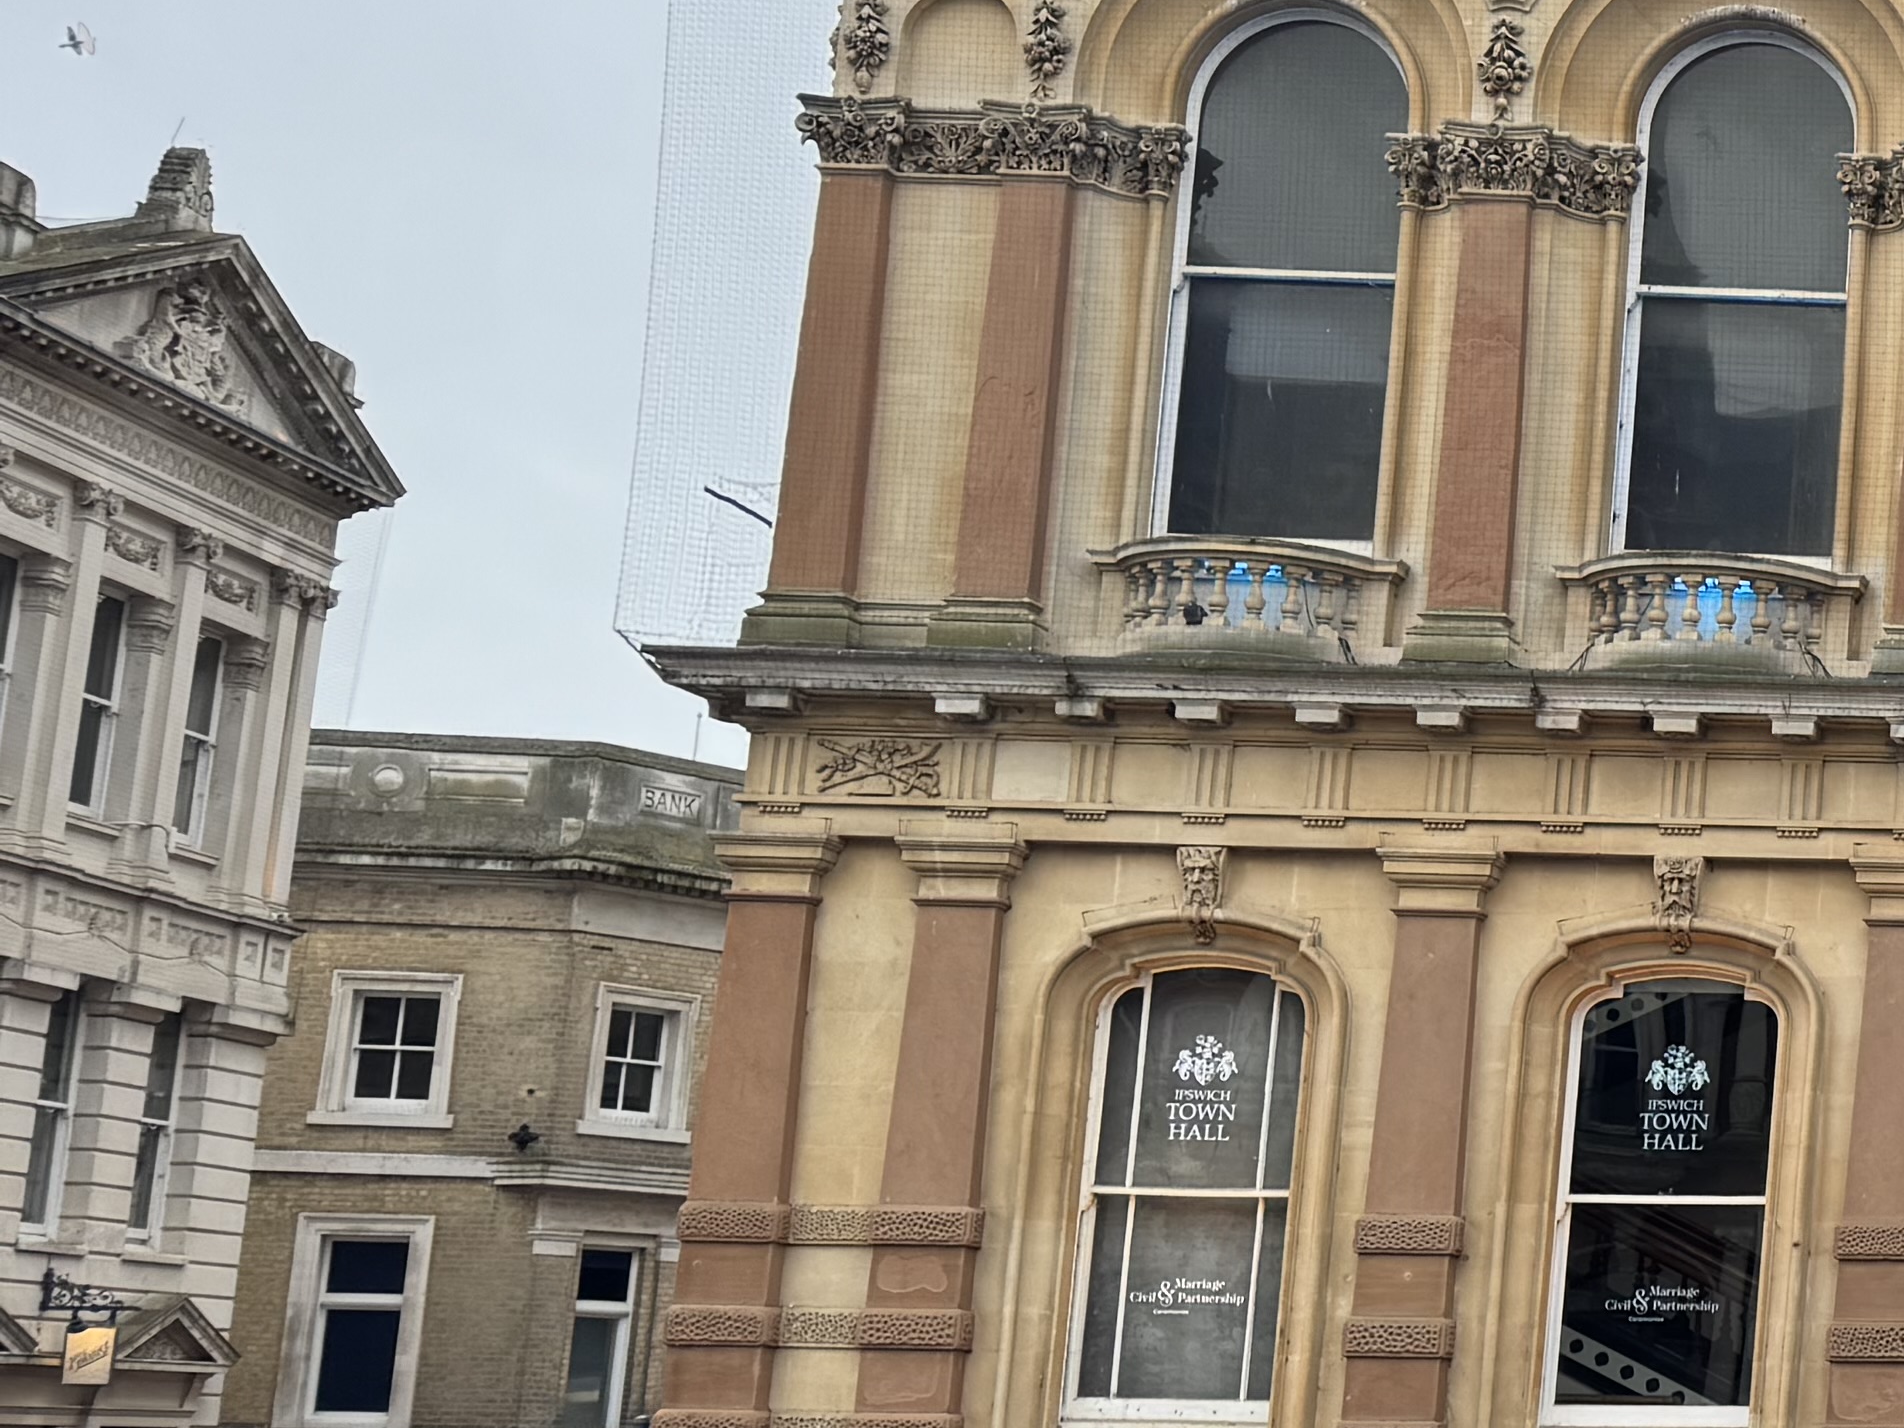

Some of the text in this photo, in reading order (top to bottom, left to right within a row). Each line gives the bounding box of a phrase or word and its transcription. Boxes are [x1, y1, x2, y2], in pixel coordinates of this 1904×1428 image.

[644, 789, 697, 816] BANK
[1174, 1088, 1231, 1101] IPSWICH
[1166, 1102, 1237, 1121] TOWN
[1648, 1099, 1704, 1111] IPSWICH
[1639, 1112, 1710, 1130] TOWN
[1168, 1123, 1230, 1141] HALL
[1642, 1133, 1704, 1151] HALL
[1174, 1277, 1226, 1292] Marriage
[1649, 1285, 1700, 1299] Marriage
[1129, 1280, 1245, 1308] Civil & Partnership
[1605, 1288, 1719, 1315] Civil & Partnership
